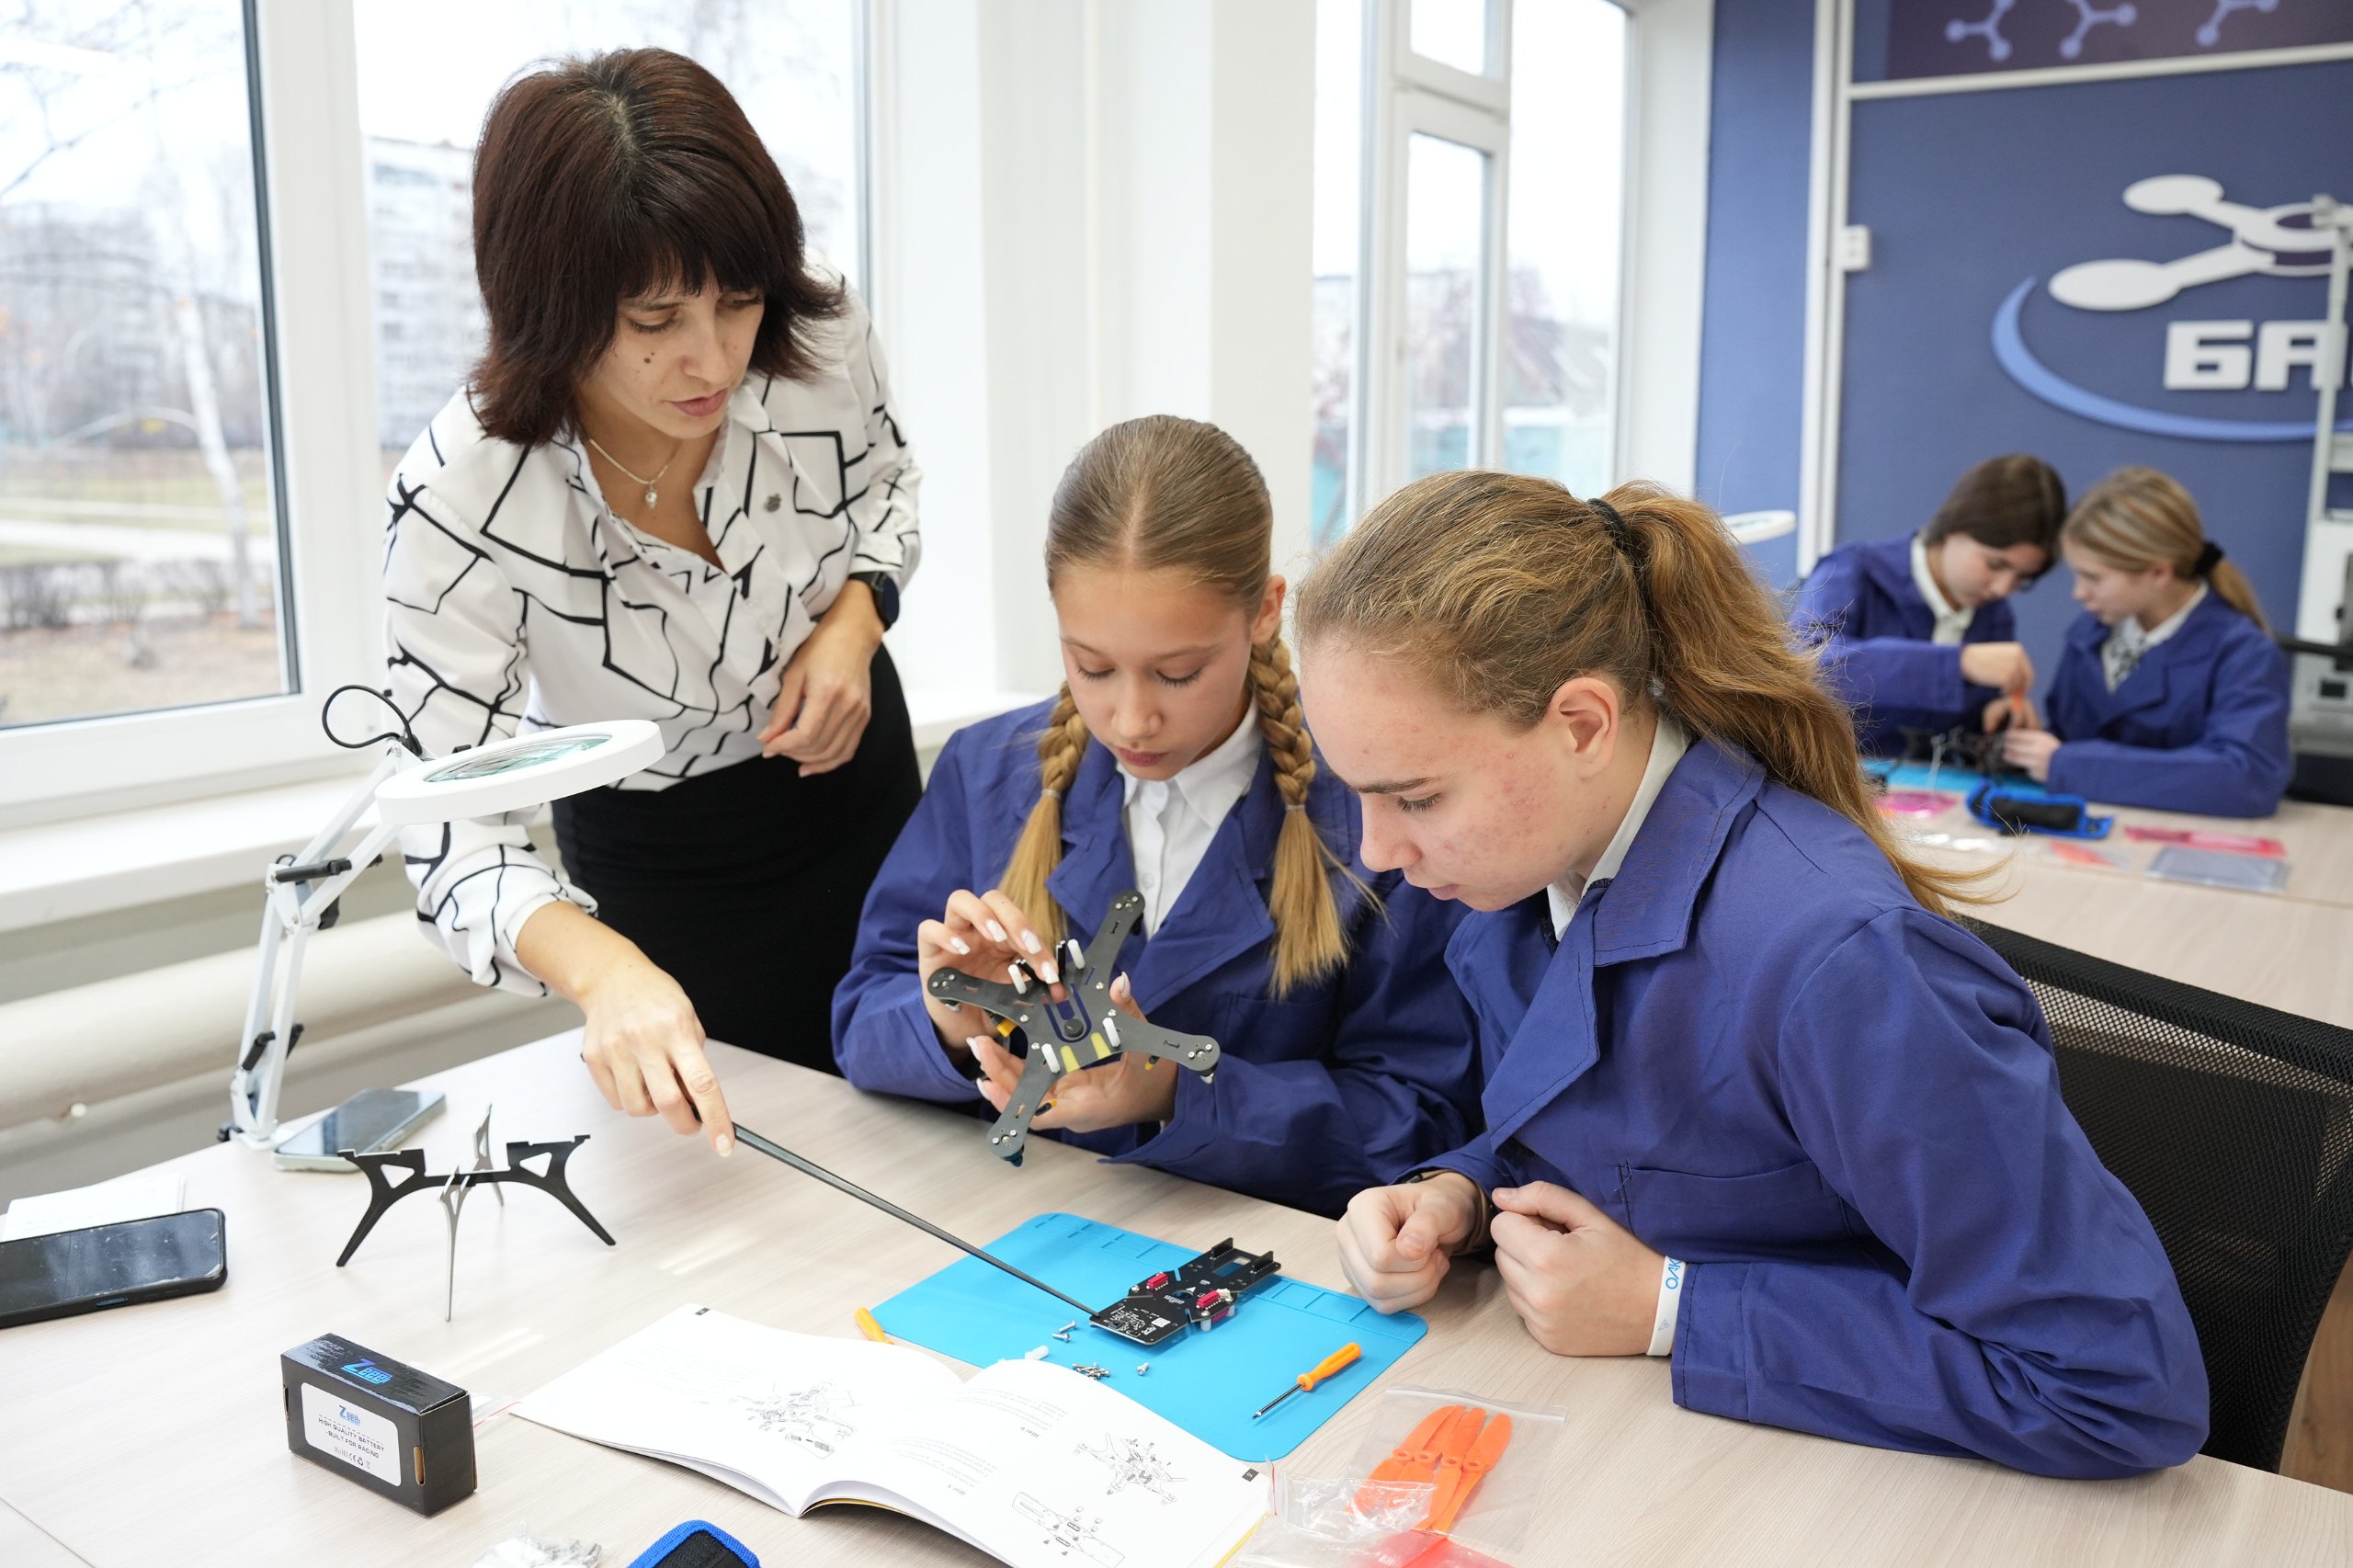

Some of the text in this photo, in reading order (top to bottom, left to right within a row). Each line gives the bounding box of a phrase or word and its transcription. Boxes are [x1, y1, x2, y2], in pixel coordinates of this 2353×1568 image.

[2164, 320, 2353, 391] БА
[318, 1417, 385, 1451] HIGH QUALITY BATTERY
[345, 1438, 357, 1448] FOR
[358, 1444, 380, 1459] RACING
